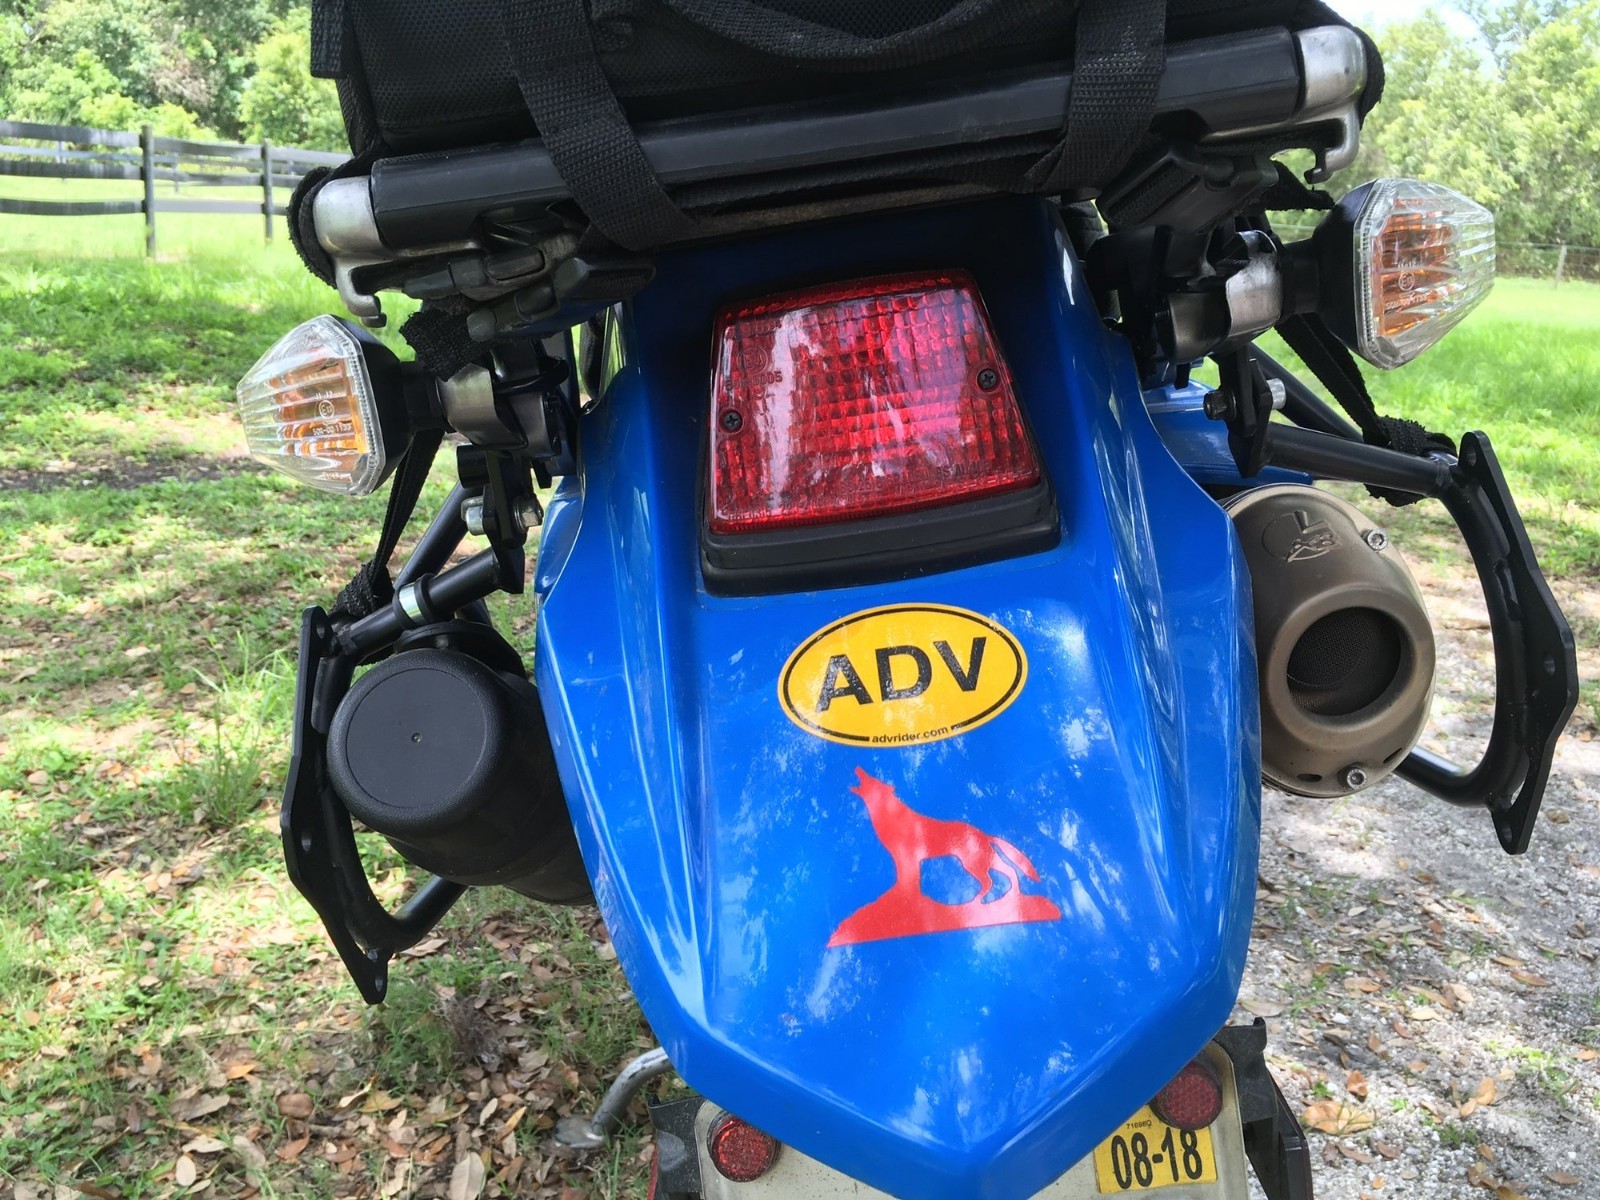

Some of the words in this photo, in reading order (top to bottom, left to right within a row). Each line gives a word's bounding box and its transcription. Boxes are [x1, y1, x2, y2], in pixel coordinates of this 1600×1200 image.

[815, 636, 987, 713] ADV
[872, 725, 949, 743] advrider.com
[1111, 1127, 1202, 1189] 08-18
